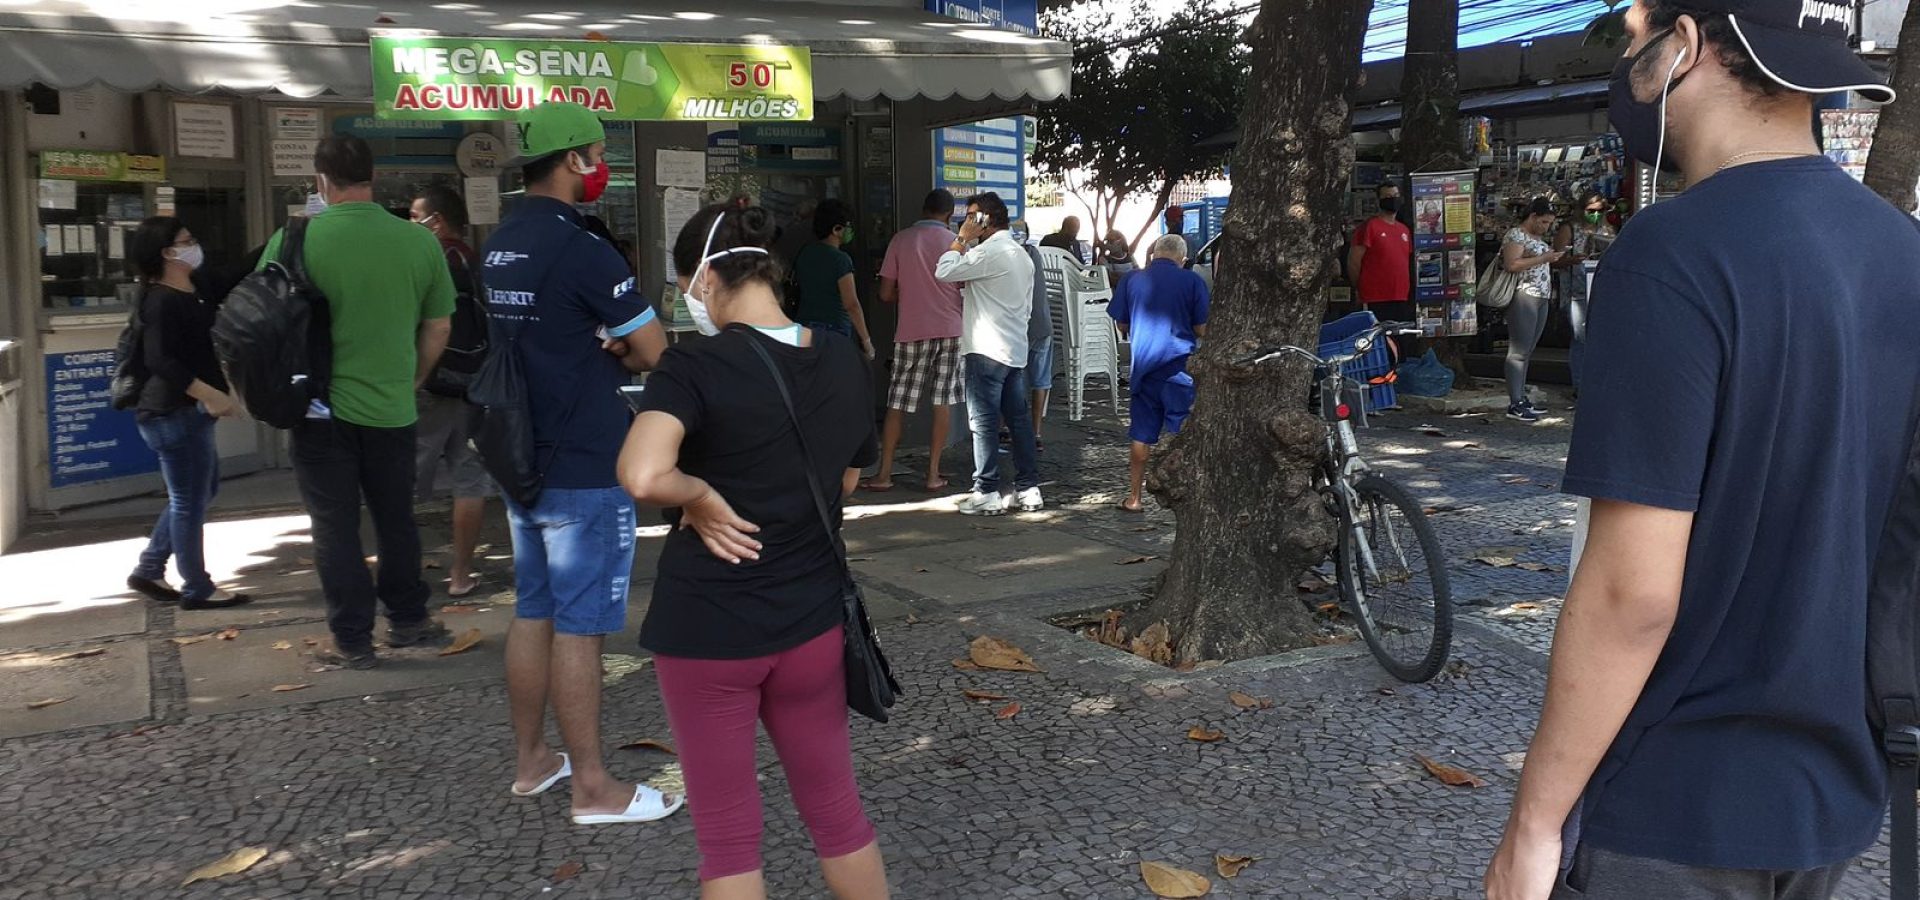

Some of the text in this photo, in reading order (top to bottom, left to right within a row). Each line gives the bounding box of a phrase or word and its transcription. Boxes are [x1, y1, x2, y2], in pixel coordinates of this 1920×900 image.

[391, 47, 614, 77] MEGA-SENA
[728, 60, 771, 90] 50
[394, 83, 616, 111] ACUMULADA
[682, 95, 798, 118] MILHÕES
[64, 352, 114, 365] COMPRE
[55, 367, 104, 380] ENTRAR
